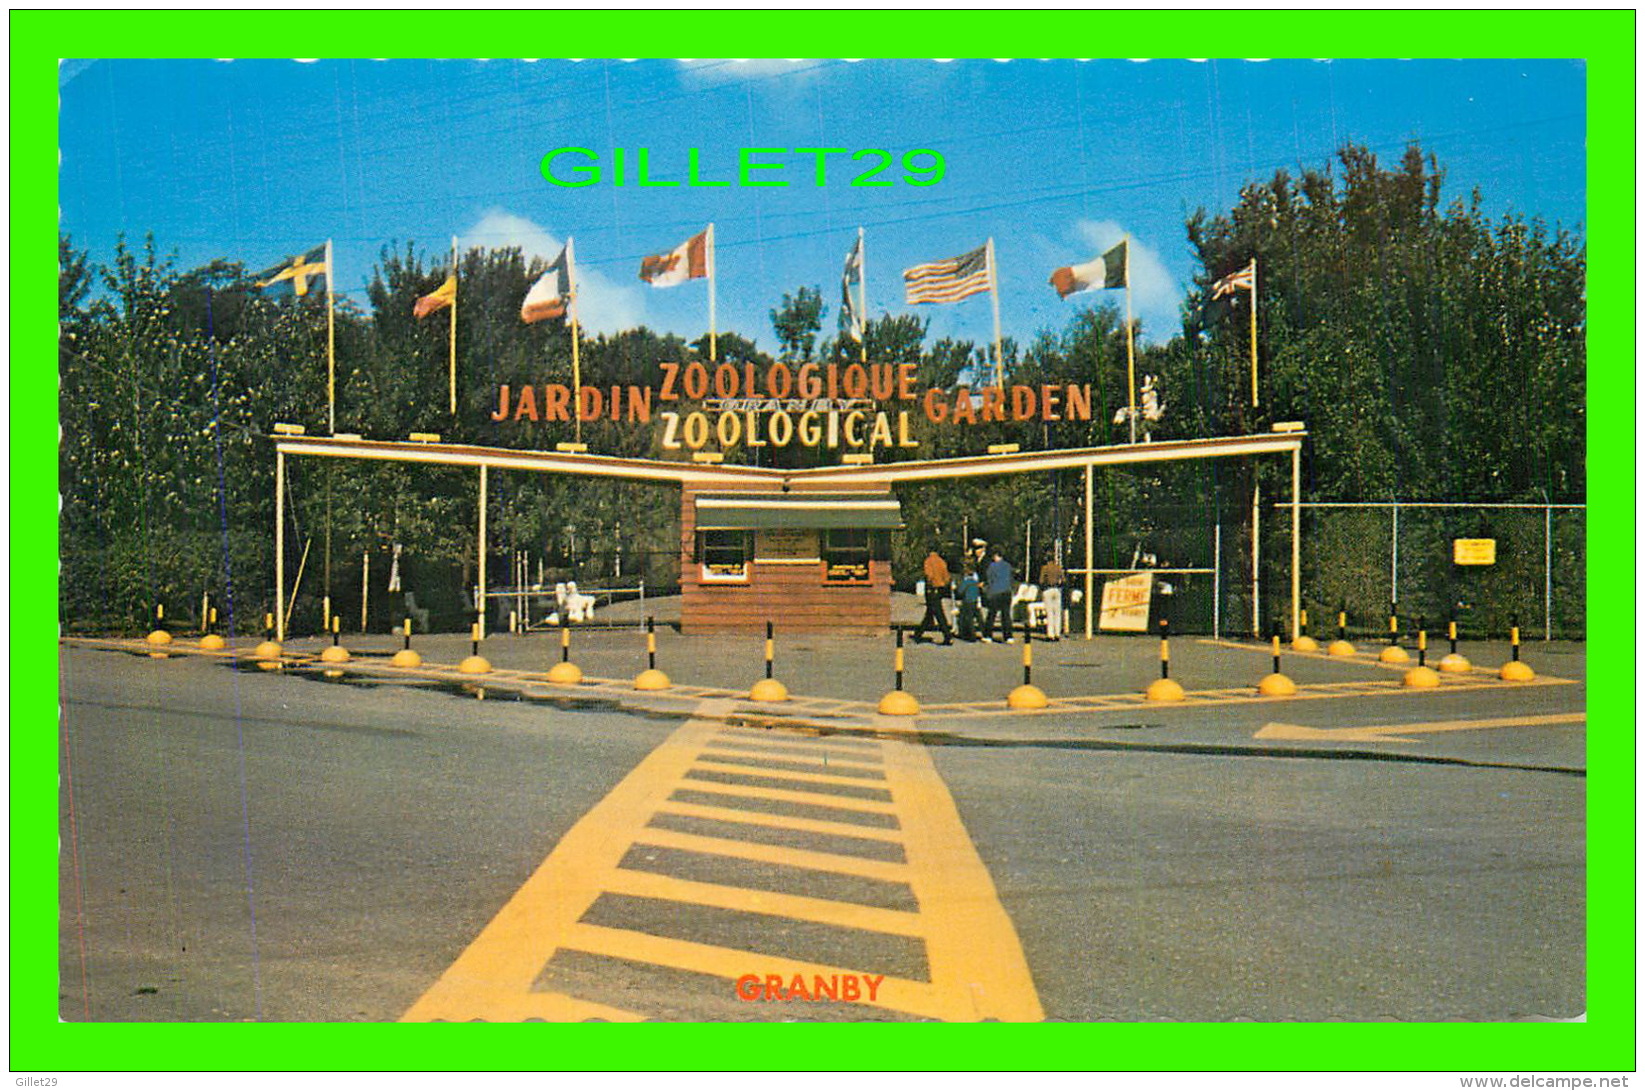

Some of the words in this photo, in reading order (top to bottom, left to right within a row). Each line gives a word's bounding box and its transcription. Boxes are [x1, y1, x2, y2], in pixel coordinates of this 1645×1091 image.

[659, 361, 917, 400] ZOOLOGIQUE
[491, 384, 652, 423] JARDIN
[924, 384, 1092, 424] GARDEN
[660, 410, 919, 449] ZOOLOGICAL
